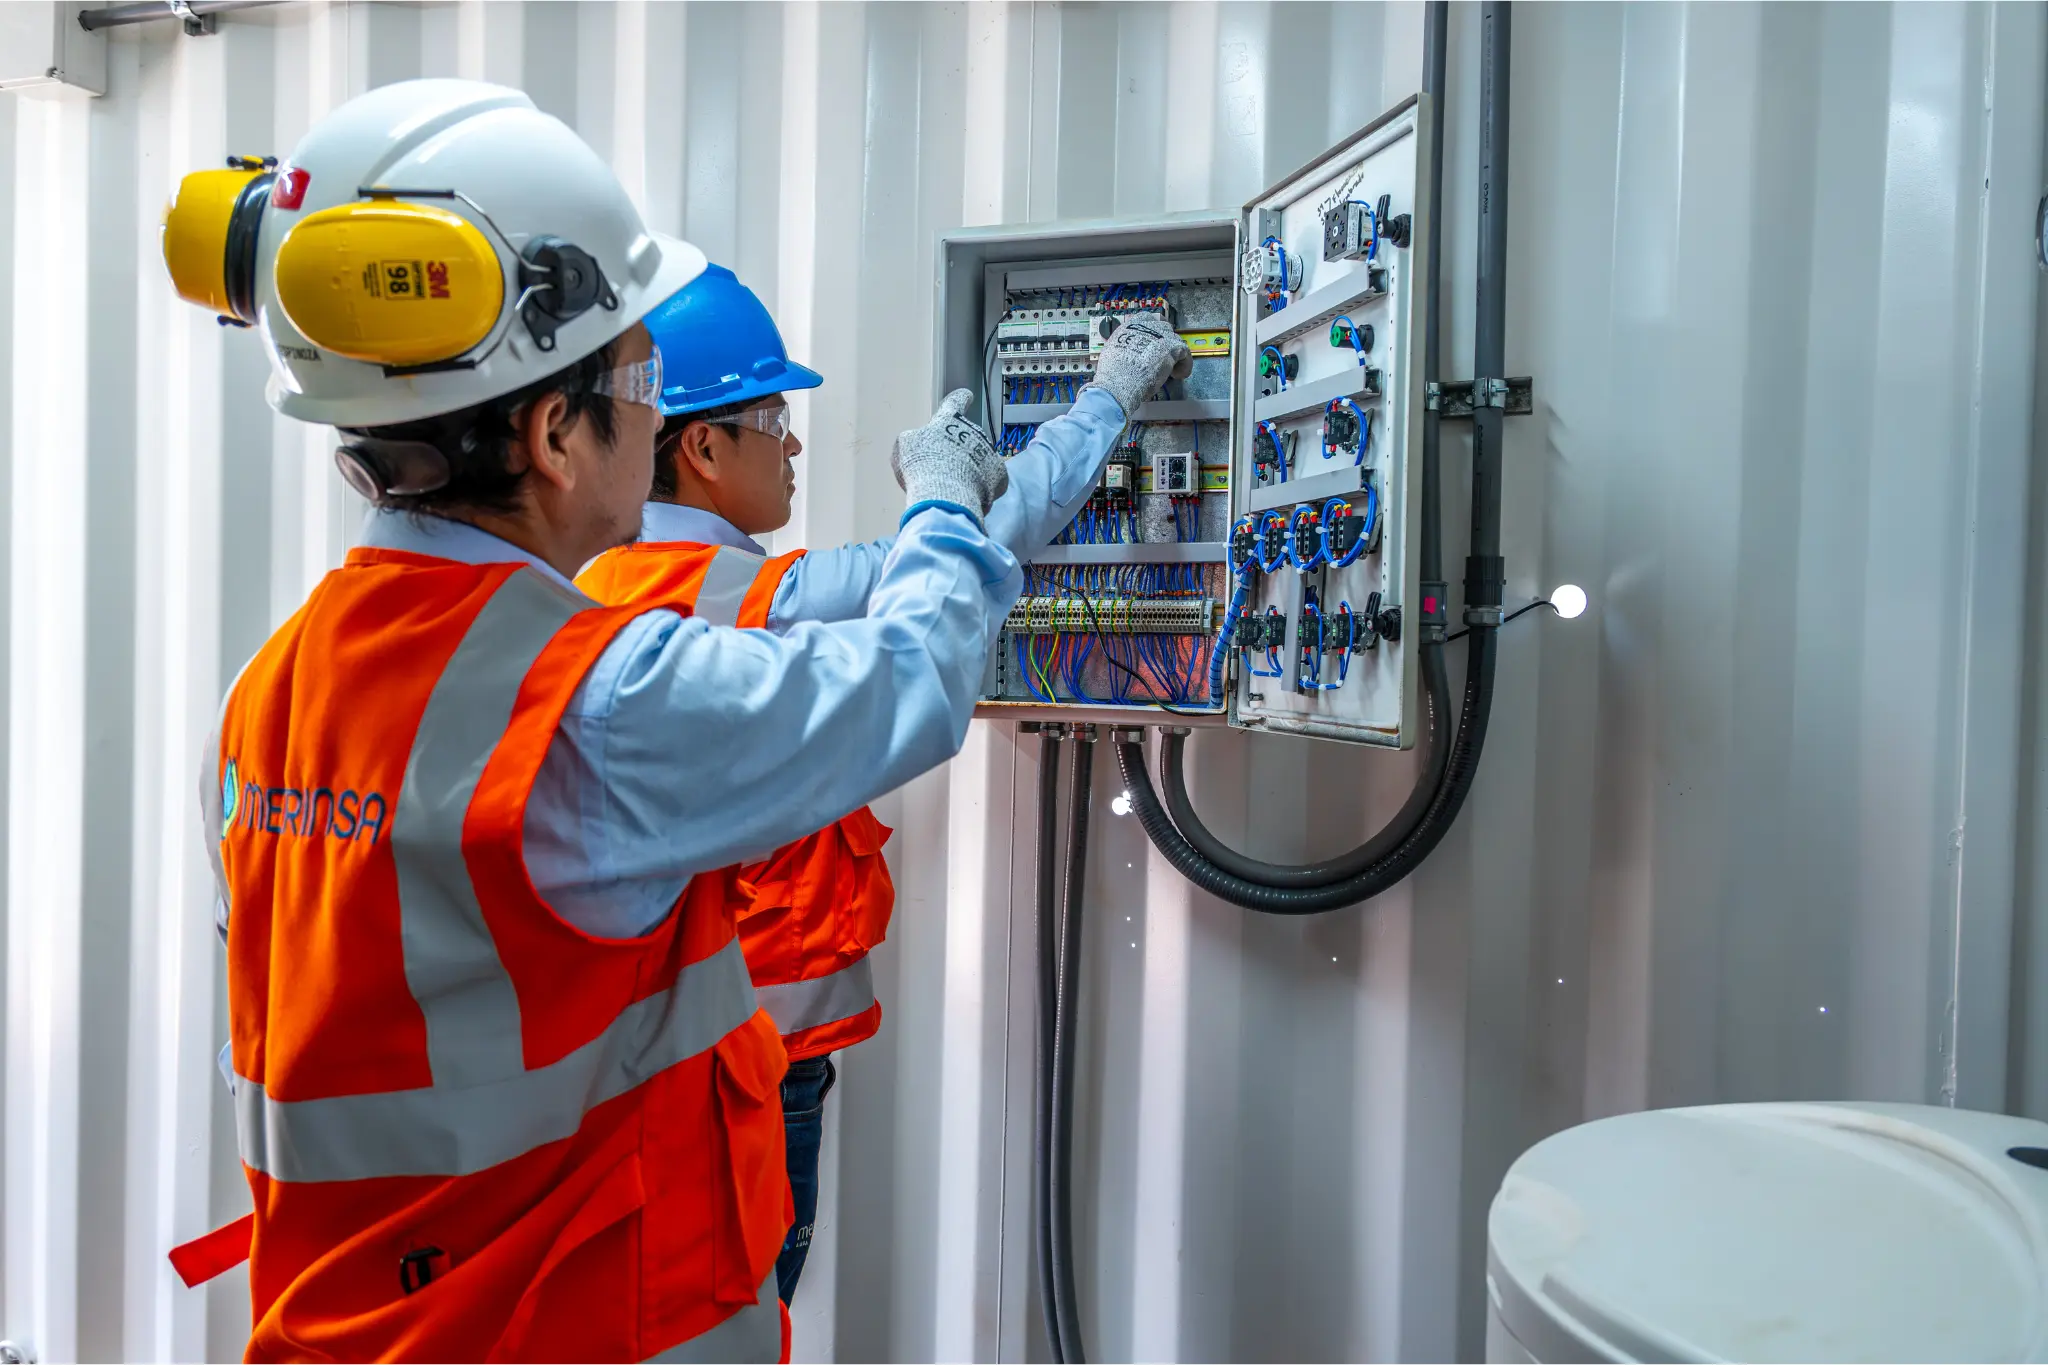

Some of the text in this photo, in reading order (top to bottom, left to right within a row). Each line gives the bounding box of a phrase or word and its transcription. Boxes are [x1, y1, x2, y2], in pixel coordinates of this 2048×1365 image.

[387, 266, 411, 294] 98
[427, 260, 451, 299] 3M
[945, 424, 971, 444] CE
